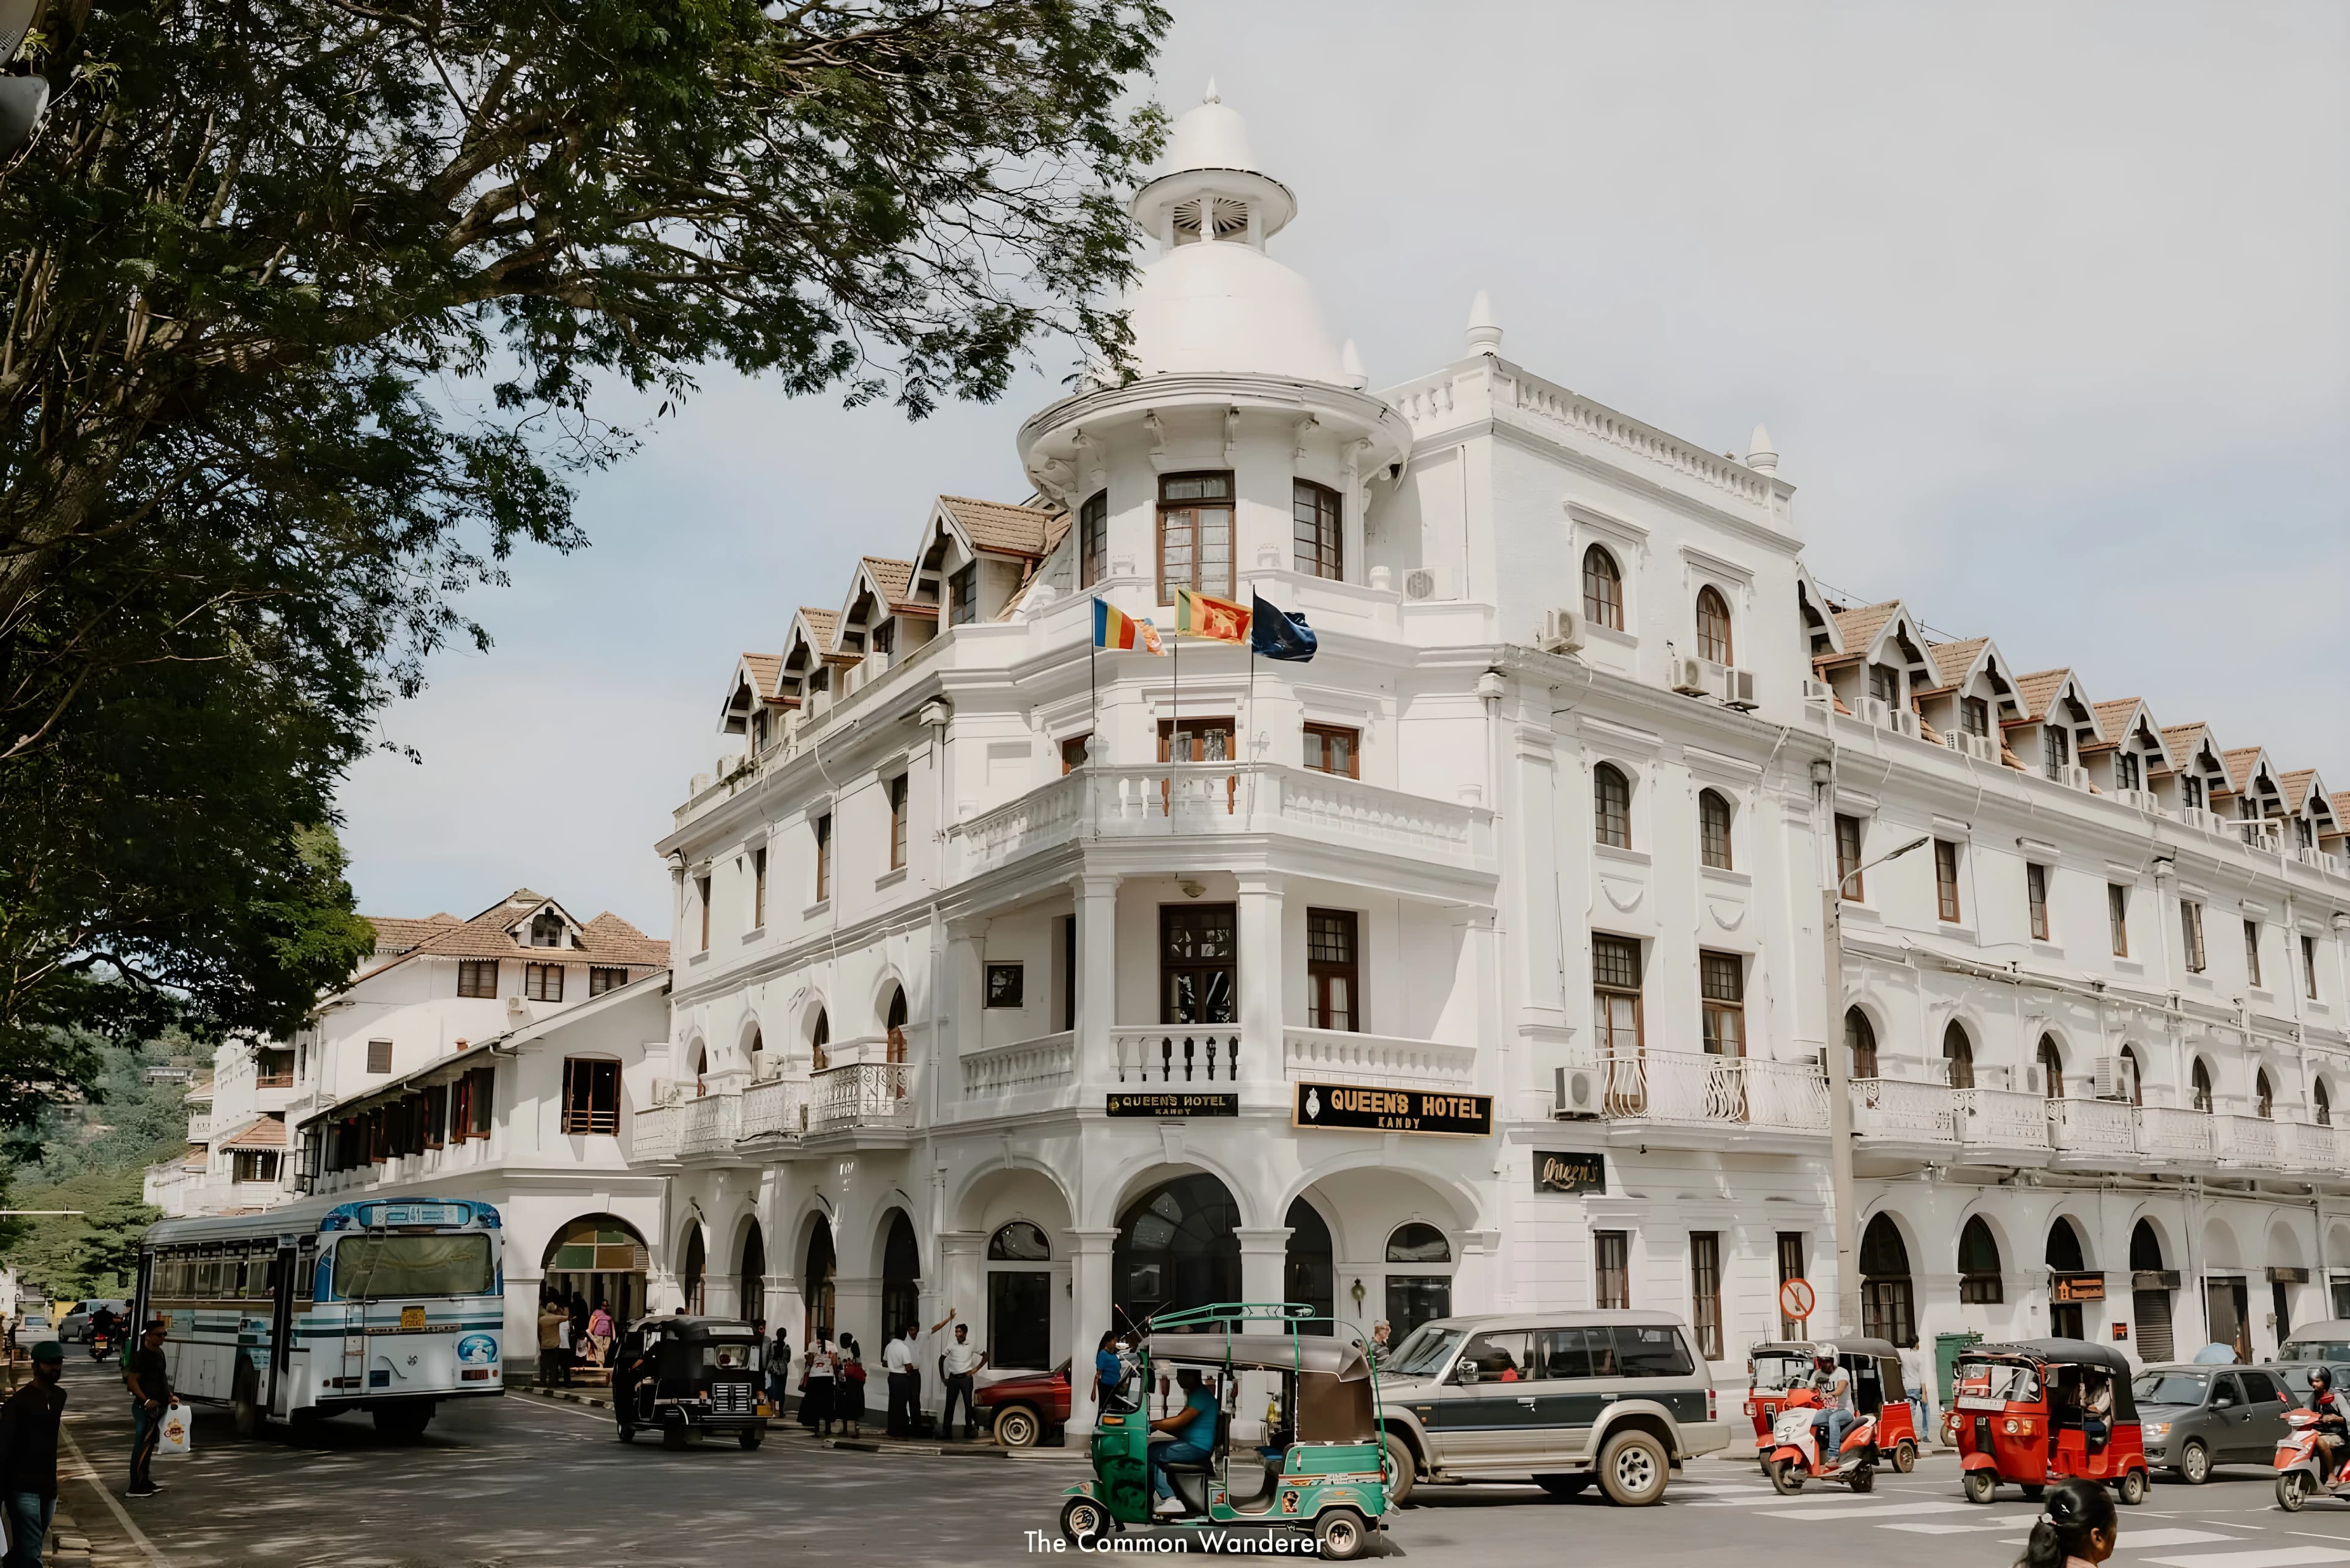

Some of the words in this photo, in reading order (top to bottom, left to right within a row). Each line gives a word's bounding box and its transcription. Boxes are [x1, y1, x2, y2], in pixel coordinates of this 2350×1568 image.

[1122, 1094, 1178, 1107] QUEEN'S
[1184, 1096, 1226, 1107] HOTEL
[1330, 1089, 1409, 1114] QUEEN'S
[1422, 1096, 1482, 1119] HOTEL
[1378, 1116, 1420, 1129] KANDY
